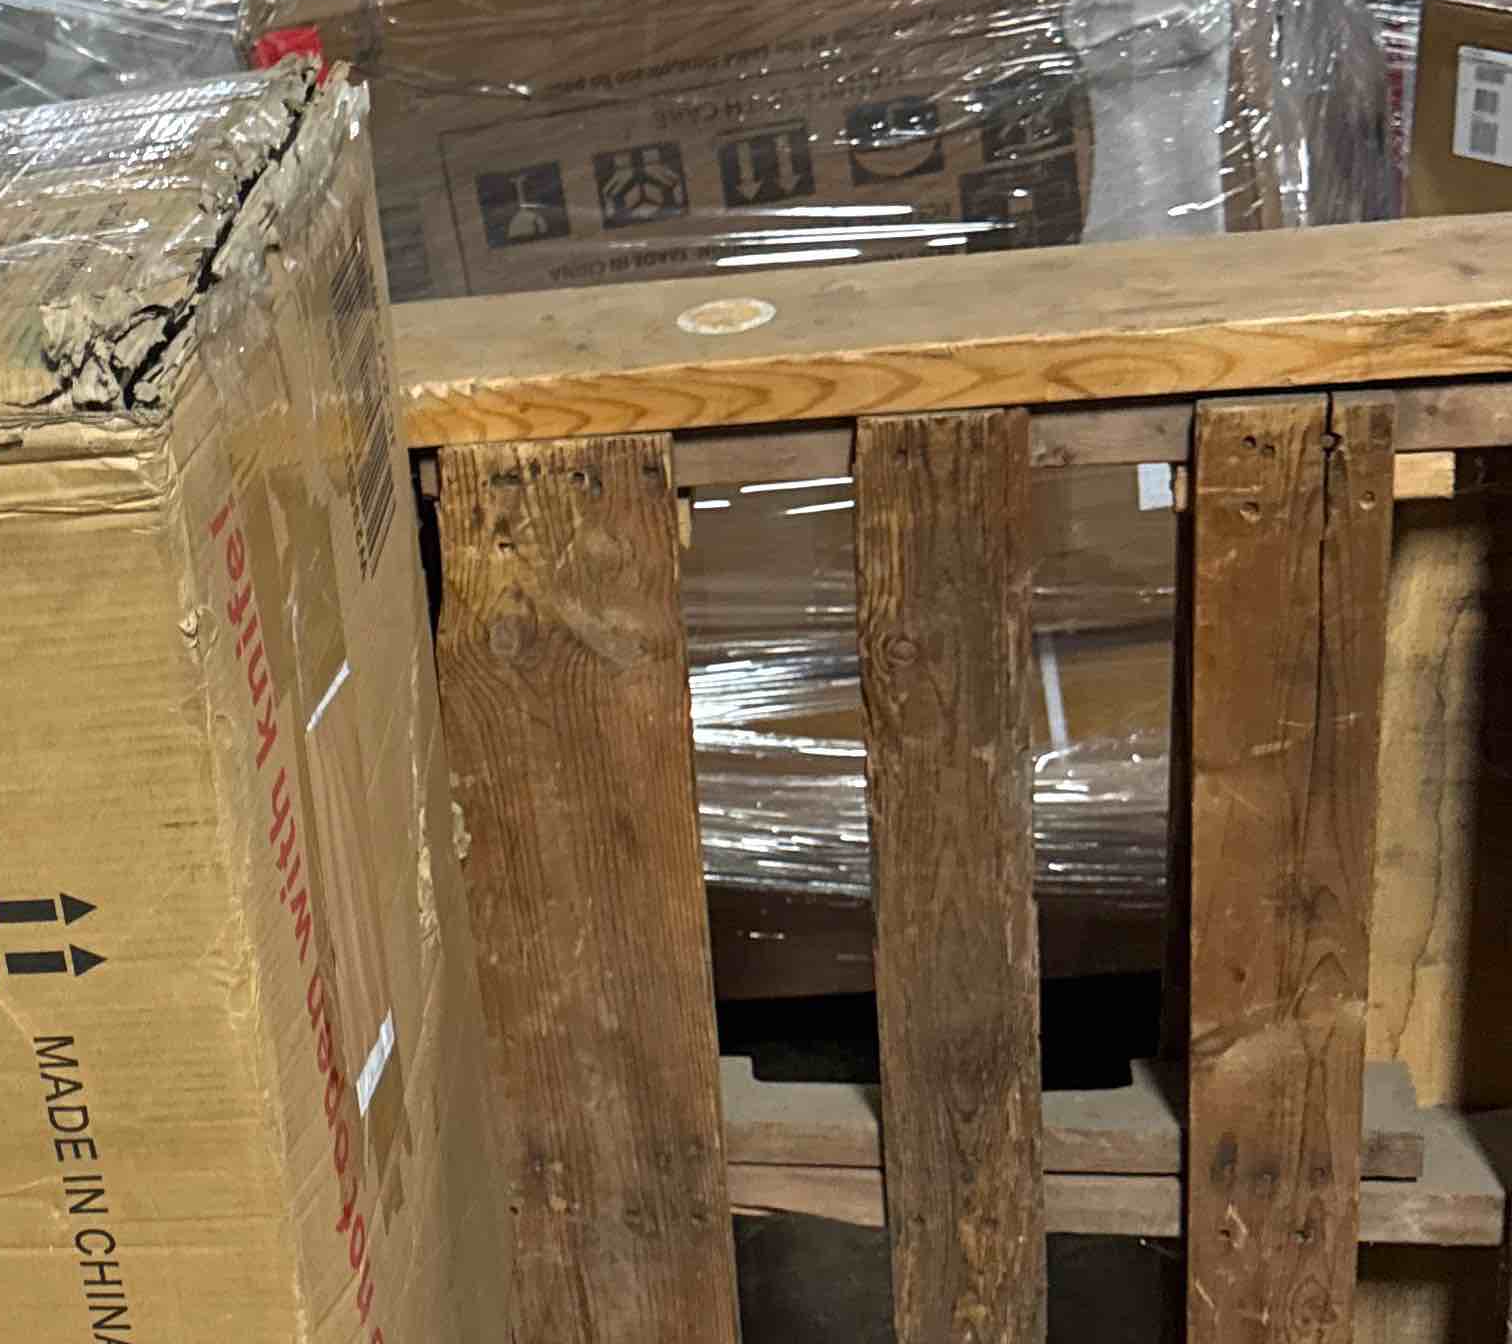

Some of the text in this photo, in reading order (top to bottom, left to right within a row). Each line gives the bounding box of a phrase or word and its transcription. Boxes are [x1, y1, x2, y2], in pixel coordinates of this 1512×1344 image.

[207, 495, 281, 769] knife!
[268, 768, 314, 962] with
[32, 1034, 98, 1163] MADE
[63, 1173, 109, 1217] IN
